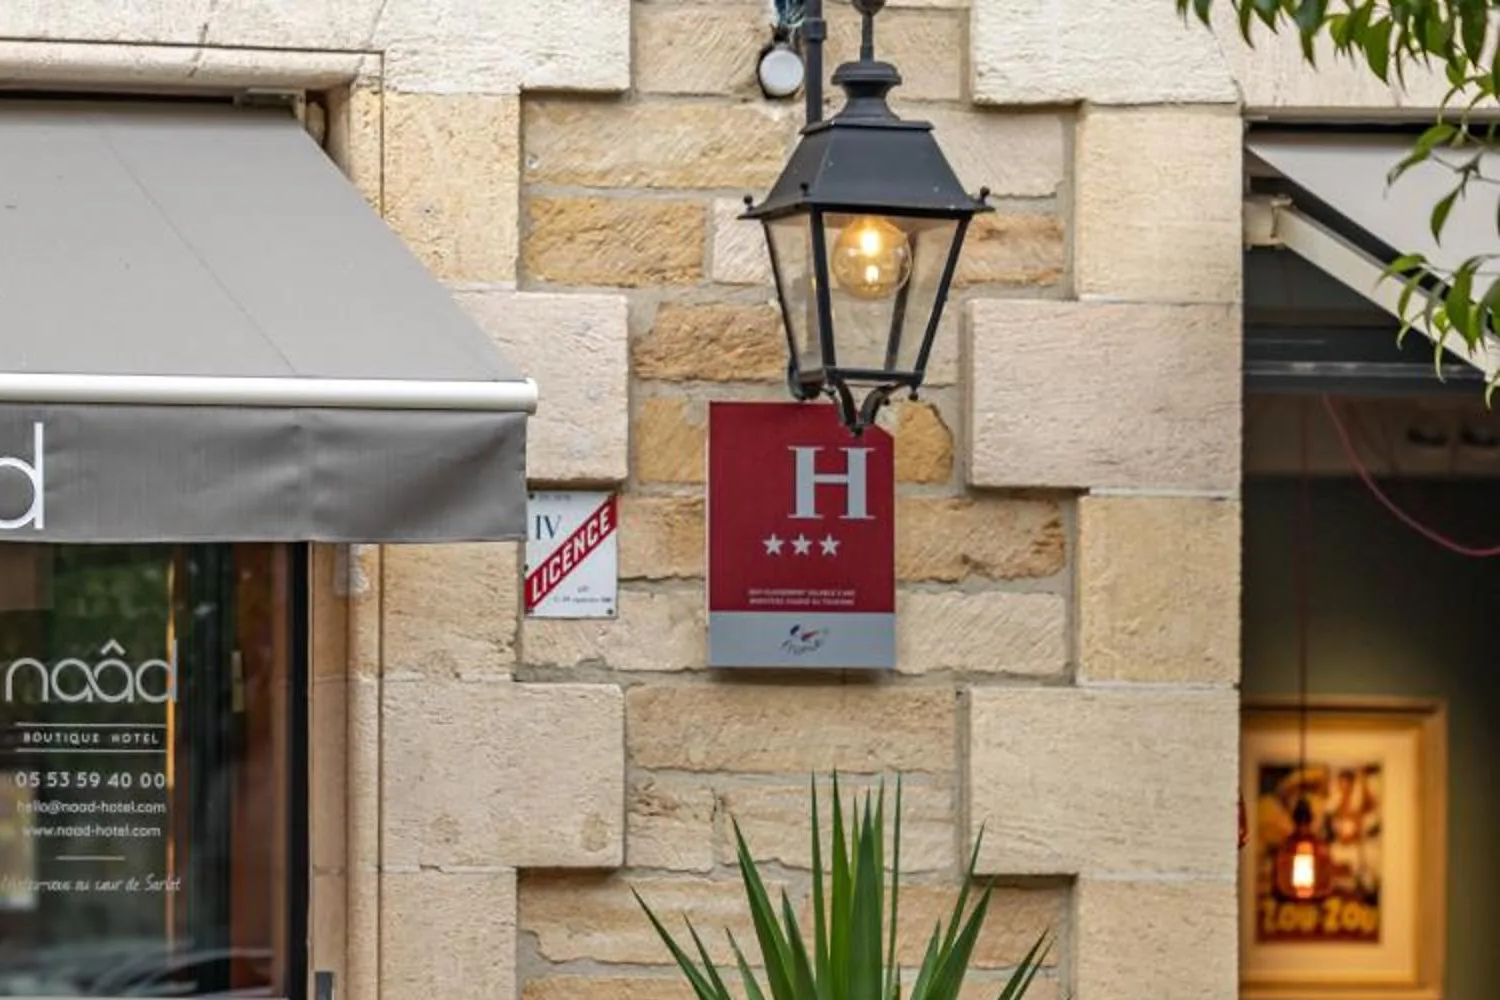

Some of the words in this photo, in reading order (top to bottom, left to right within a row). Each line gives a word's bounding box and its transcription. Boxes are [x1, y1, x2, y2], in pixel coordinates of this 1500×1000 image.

[788, 446, 876, 520] H
[536, 514, 561, 540] IV
[531, 506, 611, 604] LICENCE
[5, 638, 178, 703] naâd
[23, 731, 100, 745] BOUTIQUE
[111, 732, 160, 745] HOTEL
[14, 771, 41, 788] 05
[46, 771, 70, 788] 53
[76, 771, 100, 788] 59
[107, 771, 132, 788] 40
[139, 771, 165, 788] 00
